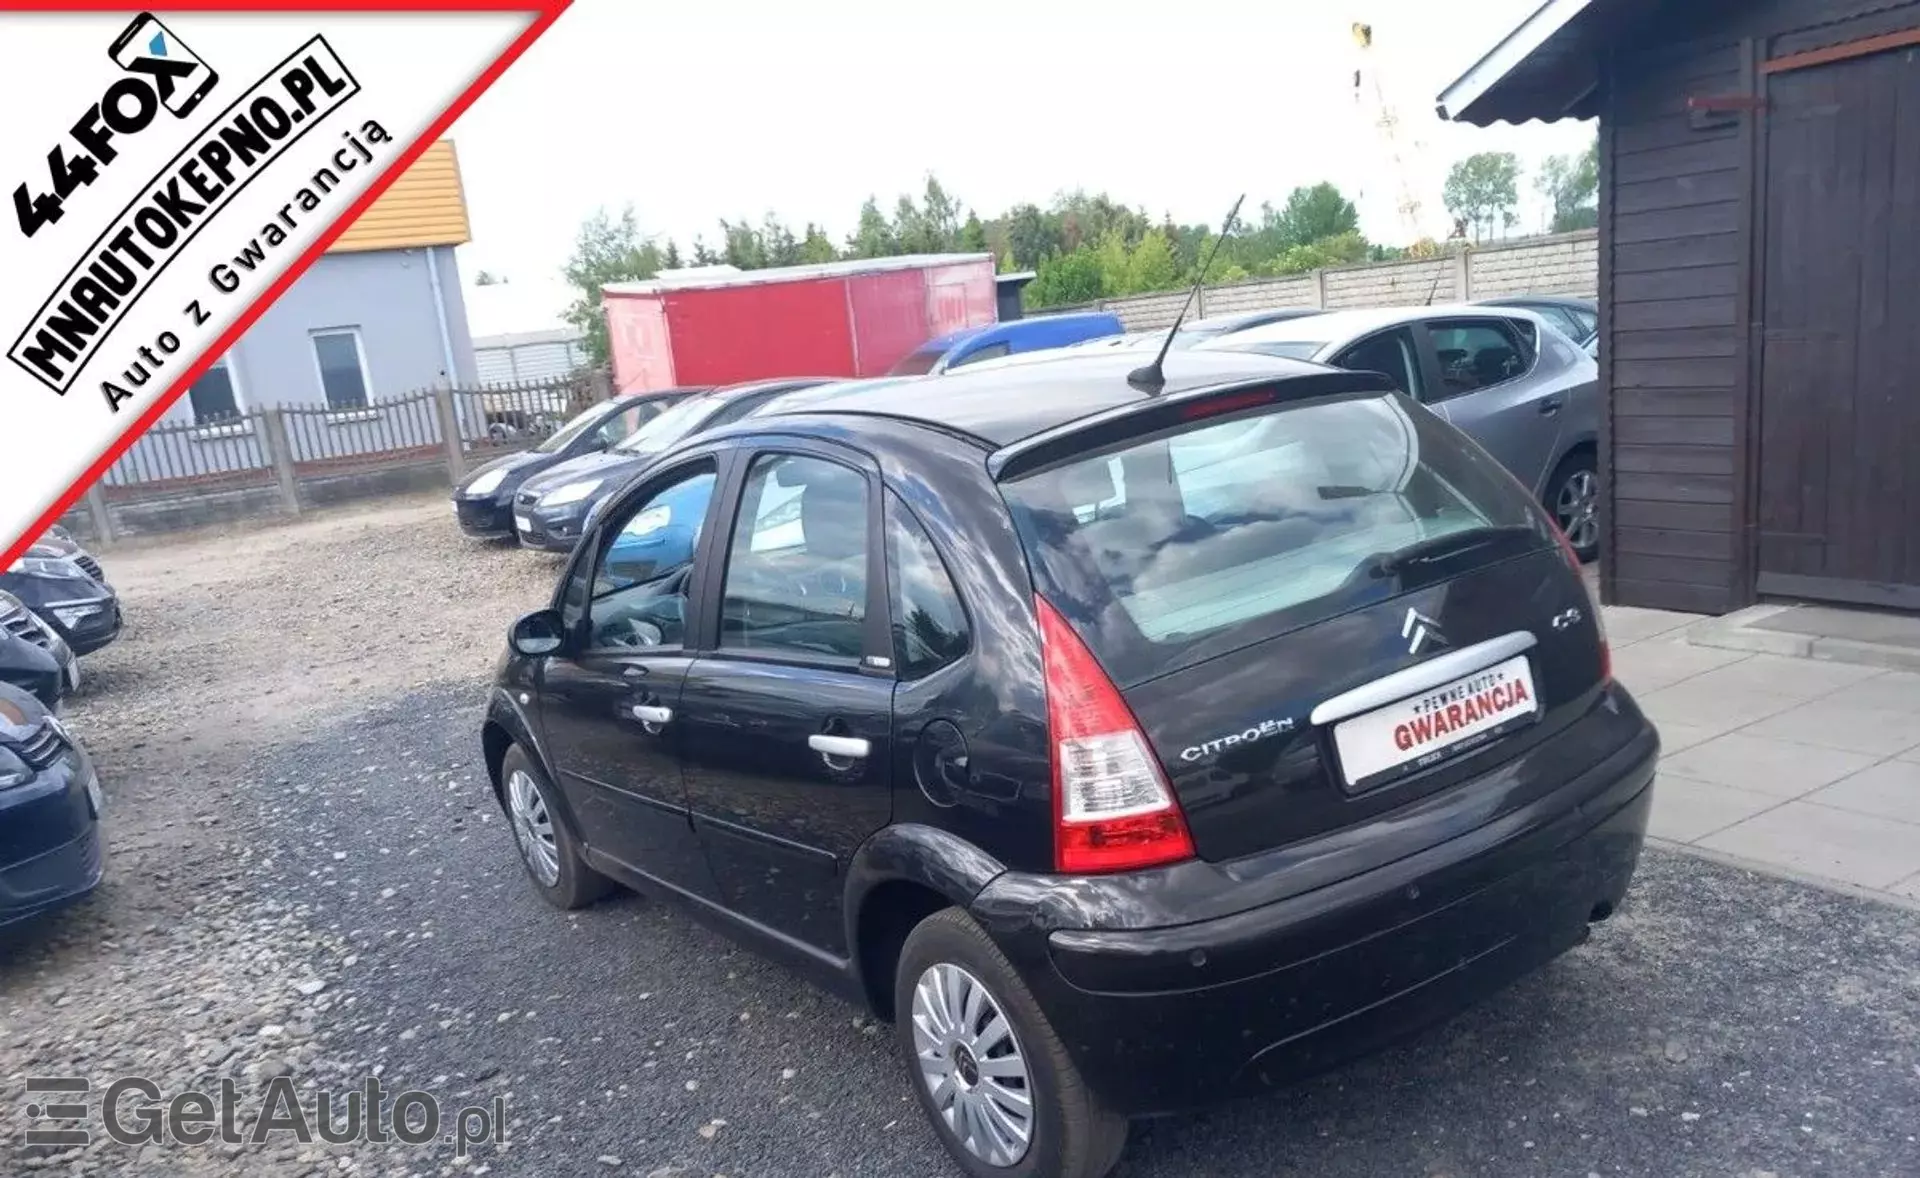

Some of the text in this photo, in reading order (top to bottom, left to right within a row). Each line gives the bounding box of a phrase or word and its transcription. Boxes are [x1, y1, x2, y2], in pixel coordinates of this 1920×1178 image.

[1394, 678, 1529, 751] GWARANCJA
[1423, 673, 1496, 712] PEWNE AUTO
